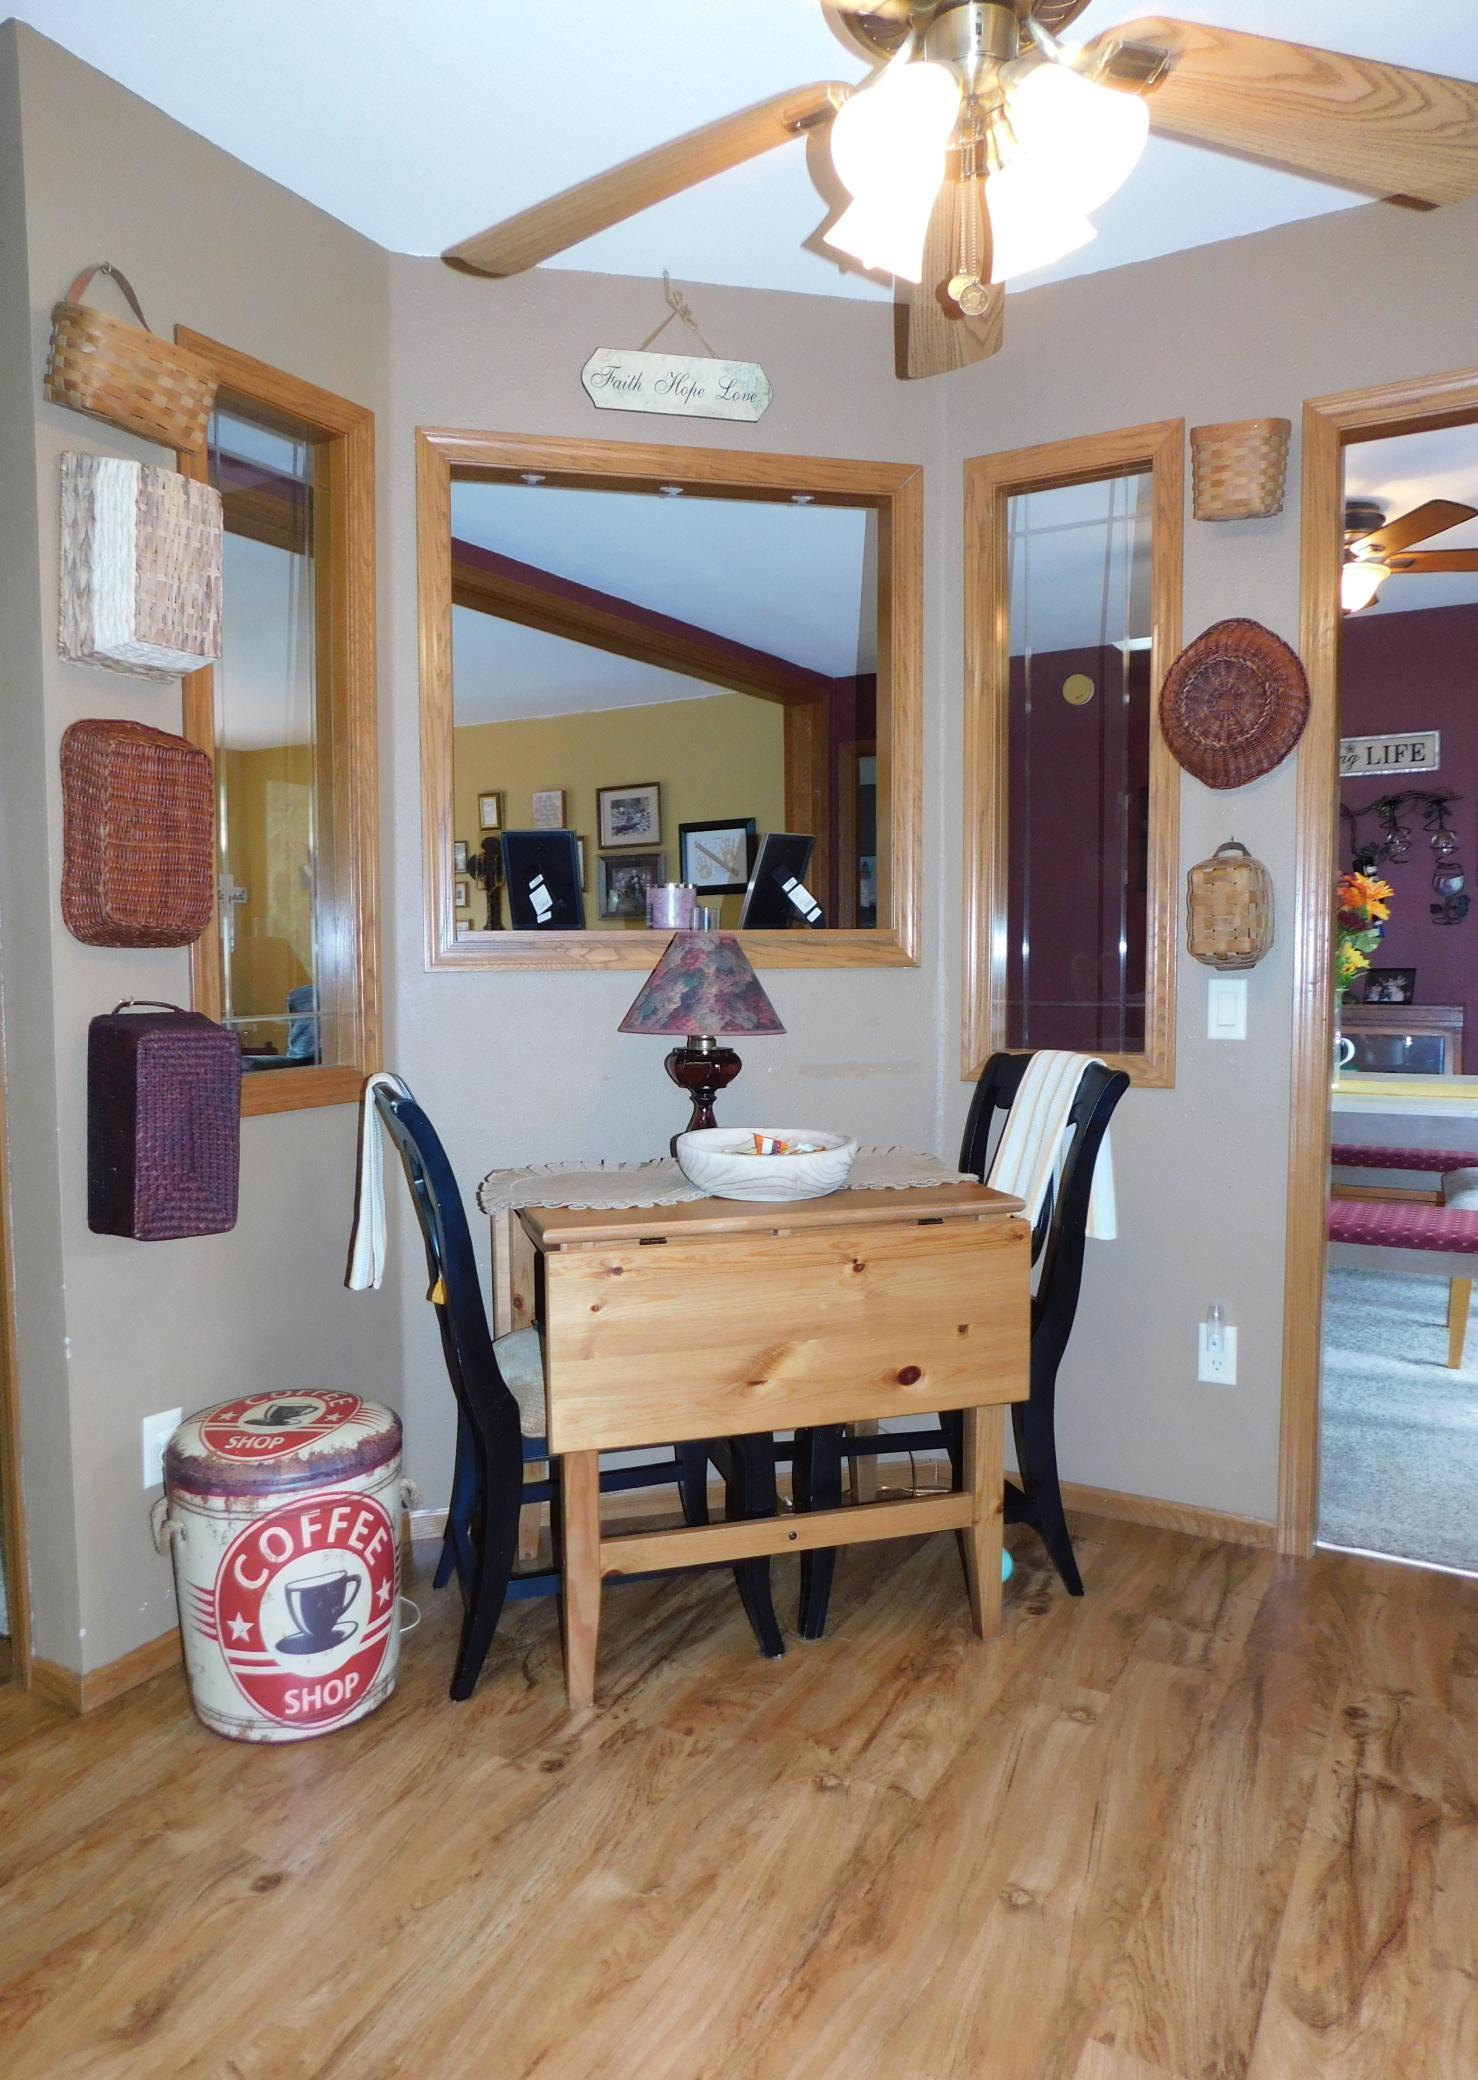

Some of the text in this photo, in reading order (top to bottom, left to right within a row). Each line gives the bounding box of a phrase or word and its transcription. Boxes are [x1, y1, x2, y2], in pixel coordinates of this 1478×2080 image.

[591, 366, 758, 404] Faith Hope Love
[1365, 743, 1426, 765] LIFE
[224, 1436, 285, 1450] SHOP
[234, 1507, 389, 1589] COFFEE
[284, 1672, 359, 1715] SHOP
